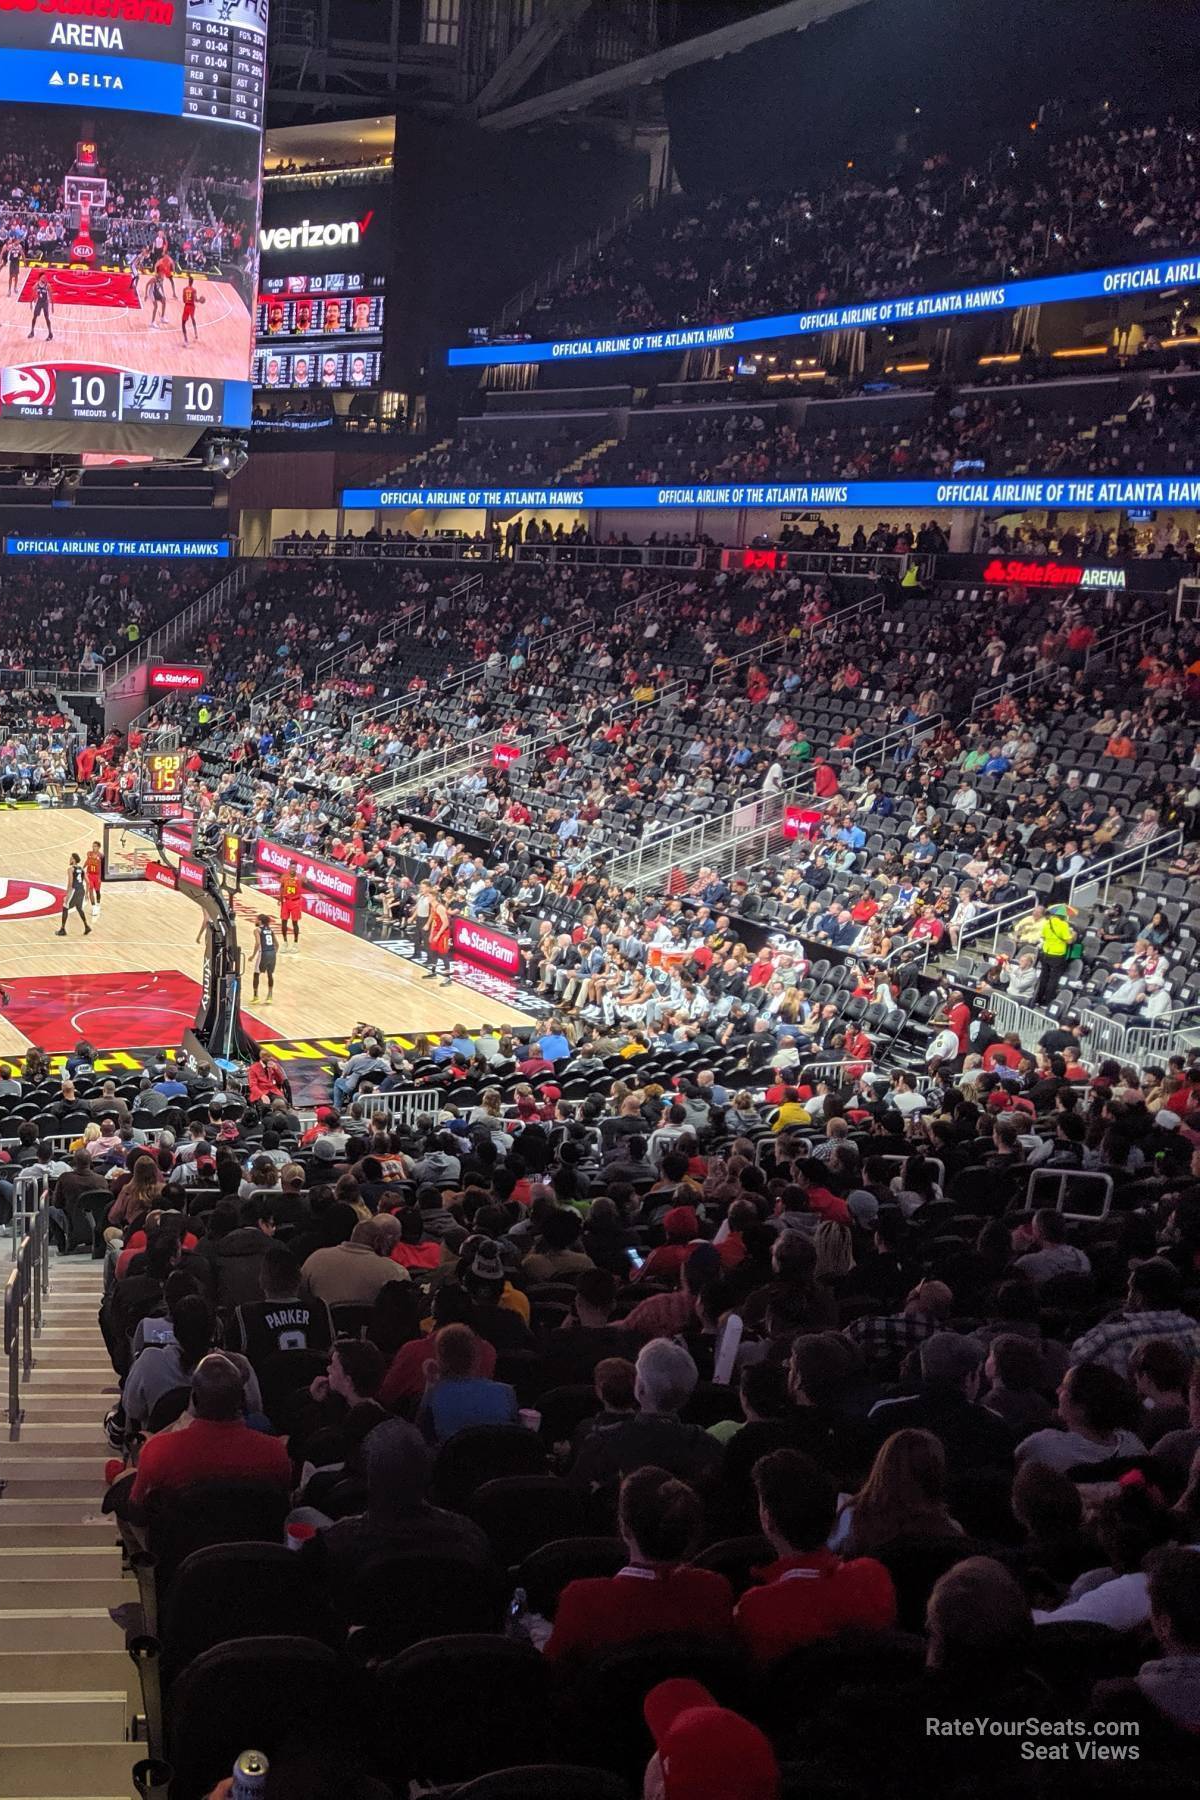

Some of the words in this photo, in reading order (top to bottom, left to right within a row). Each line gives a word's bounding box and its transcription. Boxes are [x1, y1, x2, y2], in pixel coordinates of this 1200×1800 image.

[50, 22, 124, 50] ARENA
[191, 22, 201, 31] FG
[206, 23, 229, 37] 04-12
[191, 37, 201, 48] 3P
[205, 41, 228, 53] 01-04
[190, 54, 200, 63] FT
[204, 56, 228, 68] 01-04
[68, 72, 124, 90] DELTA
[190, 70, 204, 80] REB
[236, 78, 249, 88] AST
[189, 86, 203, 97] BLK
[236, 94, 247, 104] STL
[188, 102, 198, 112] TO
[235, 109, 247, 120] FLS
[258, 219, 360, 250] verizon
[268, 278, 284, 288] 6:03
[310, 276, 322, 288] 10
[348, 274, 360, 286] 10
[1103, 268, 1160, 291] OFFICIAL
[800, 312, 838, 329] OFFICIAL
[840, 306, 877, 324] AIRLINE
[879, 304, 892, 319] OF
[895, 301, 914, 317] THE
[915, 295, 962, 314] ATLANTA
[965, 288, 1004, 308] HAWKS
[552, 342, 592, 356] OFFICIAL
[595, 338, 630, 352] AIRLINE
[632, 337, 644, 349] OF
[646, 335, 662, 347] THE
[664, 331, 704, 346] ATLANTA
[706, 326, 733, 341] HAWKS
[71, 376, 106, 406] 10
[184, 382, 213, 411] 10
[20, 407, 43, 415] FOULS
[74, 409, 107, 418] TIMEOUTS
[140, 411, 160, 420] FOULS
[186, 414, 215, 423] TIMEOUTS
[380, 492, 423, 504] OFFICIAL
[426, 492, 465, 504] AIRLINE
[468, 492, 480, 504] OF
[483, 492, 501, 504] THE
[503, 492, 546, 504] ATLANTA
[549, 491, 583, 504] HAWKS
[658, 489, 694, 503] OFFICIAL
[696, 488, 730, 502] AIRLINE
[732, 488, 744, 502] OF
[746, 488, 763, 502] THE
[765, 487, 808, 502] ATLANTA
[810, 487, 847, 501] HAWKS
[937, 485, 988, 501] OFFICIAL
[992, 484, 1042, 501] AIRLINE
[1046, 484, 1064, 501] OF
[1068, 484, 1094, 501] THE
[1098, 483, 1163, 501] ATLANTA
[16, 541, 58, 552] OFFICIAL
[62, 542, 99, 552] AIRLINE
[102, 542, 115, 552] OF
[118, 542, 135, 553] THE
[138, 543, 180, 553] ATLANTA
[183, 544, 218, 554] HAWKS
[1080, 569, 1126, 586] ARENA
[154, 756, 180, 770] 6:03
[156, 770, 176, 791] 15
[154, 794, 182, 802] TISSOT
[286, 886, 296, 894] 24
[316, 869, 353, 897] StateFarm
[265, 934, 274, 946] 8
[470, 931, 514, 964] StateFarm
[201, 957, 212, 1011] xfinity
[264, 1308, 310, 1329] PARKER
